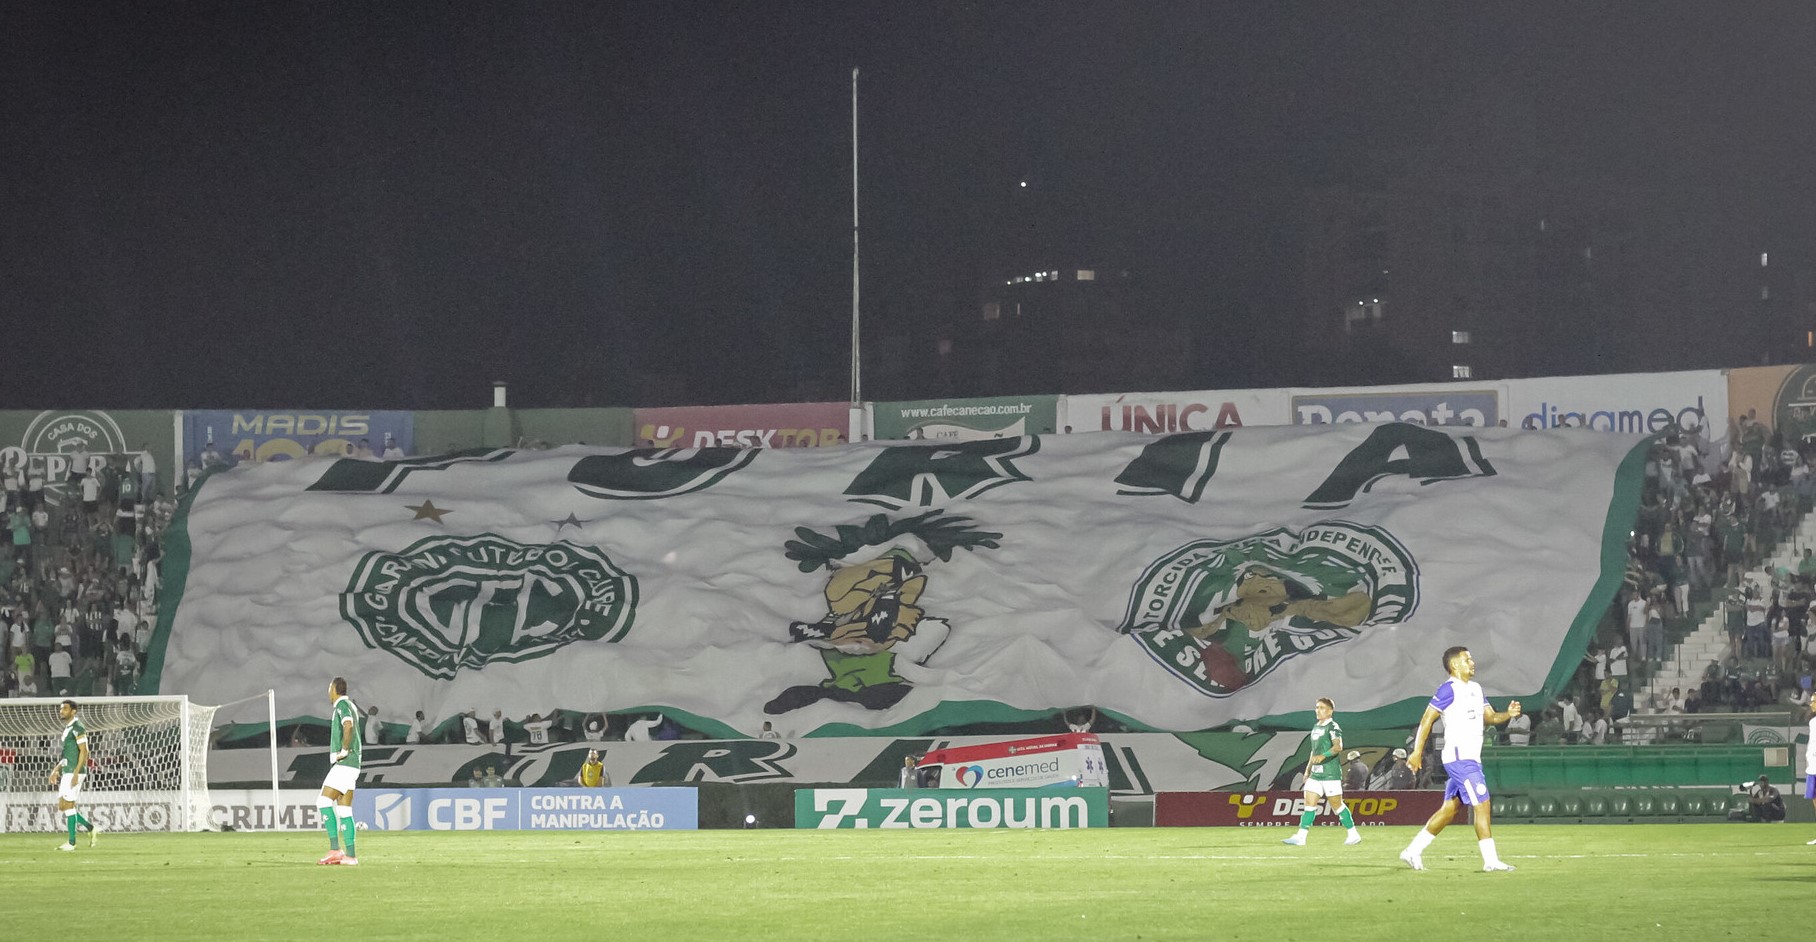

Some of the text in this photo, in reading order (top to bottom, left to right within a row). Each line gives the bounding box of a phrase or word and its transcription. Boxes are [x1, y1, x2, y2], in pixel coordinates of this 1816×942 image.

[901, 403, 1032, 418] www.cafecanecao.com.br
[1102, 395, 1242, 434] ÚNICA
[47, 422, 98, 441] CASA DOS
[232, 415, 370, 436] MADIS
[122, 483, 131, 494] 10
[1143, 552, 1209, 619] TORCIDA
[987, 757, 1059, 779] cenemed
[531, 795, 624, 810] CONTRA A
[880, 796, 1089, 829] zeroum
[428, 798, 508, 830] CBF
[531, 810, 665, 830] MANIPULAÇÃO
